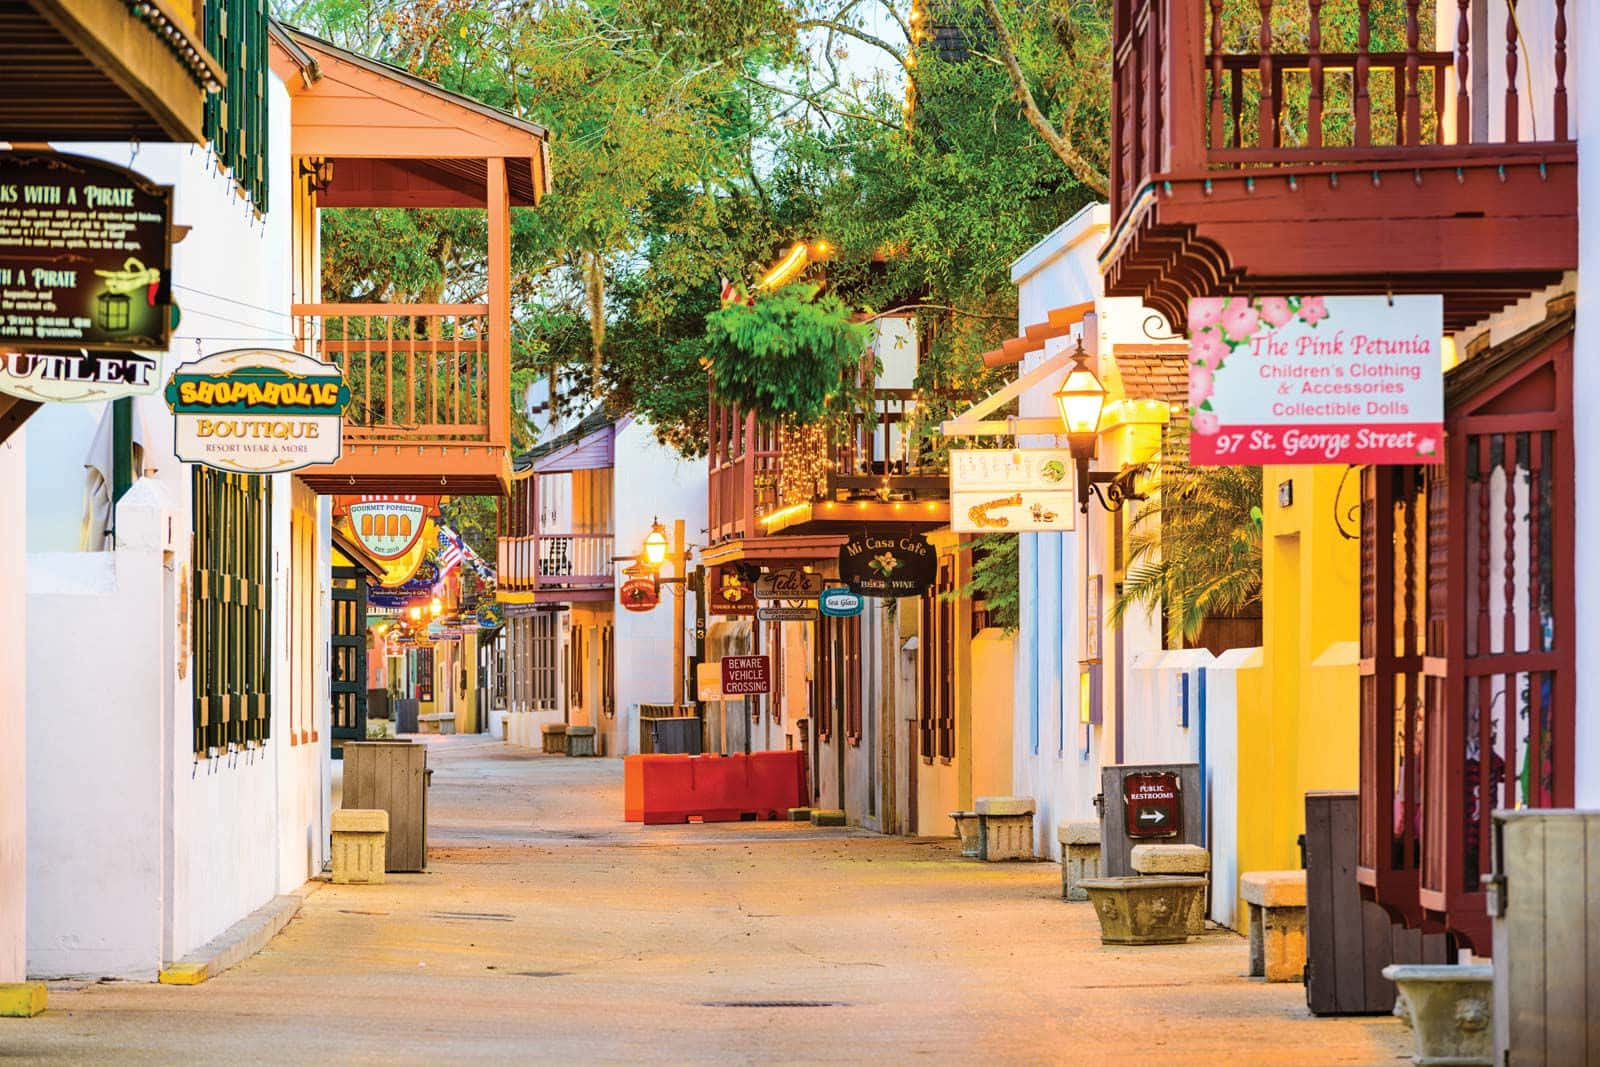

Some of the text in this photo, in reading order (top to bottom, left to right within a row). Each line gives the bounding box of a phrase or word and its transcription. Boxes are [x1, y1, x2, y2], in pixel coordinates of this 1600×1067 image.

[24, 185, 61, 205] WITH
[67, 186, 77, 205] A
[83, 185, 135, 209] PIRATE
[32, 267, 78, 290] PIRATE
[1251, 331, 1430, 357] The Pink Petunia
[0, 352, 156, 386] UTLET
[1259, 362, 1421, 381] Children's Clothing
[180, 380, 340, 407] SHOPAHOLIC
[1277, 379, 1404, 396] & Accessories
[1271, 401, 1409, 417] Collectible Dolls
[196, 418, 320, 441] BOUTIQUE
[206, 444, 240, 453] RESORT
[243, 444, 269, 453] WEAR
[281, 444, 308, 453] MORE
[1215, 427, 1417, 459] 97 St. George Street
[351, 504, 422, 513] GOURMET POPSICLES
[846, 537, 928, 557] Mi Casa Cafe
[764, 570, 813, 594] Tedi's
[892, 580, 915, 589] WINE
[827, 597, 839, 606] Sea
[728, 657, 763, 669] BEWARE
[729, 669, 764, 681] VEHICLE
[726, 681, 767, 693] CROSSING
[1131, 792, 1174, 800] RESTROOMS
[1139, 784, 1165, 793] PUBLIC
